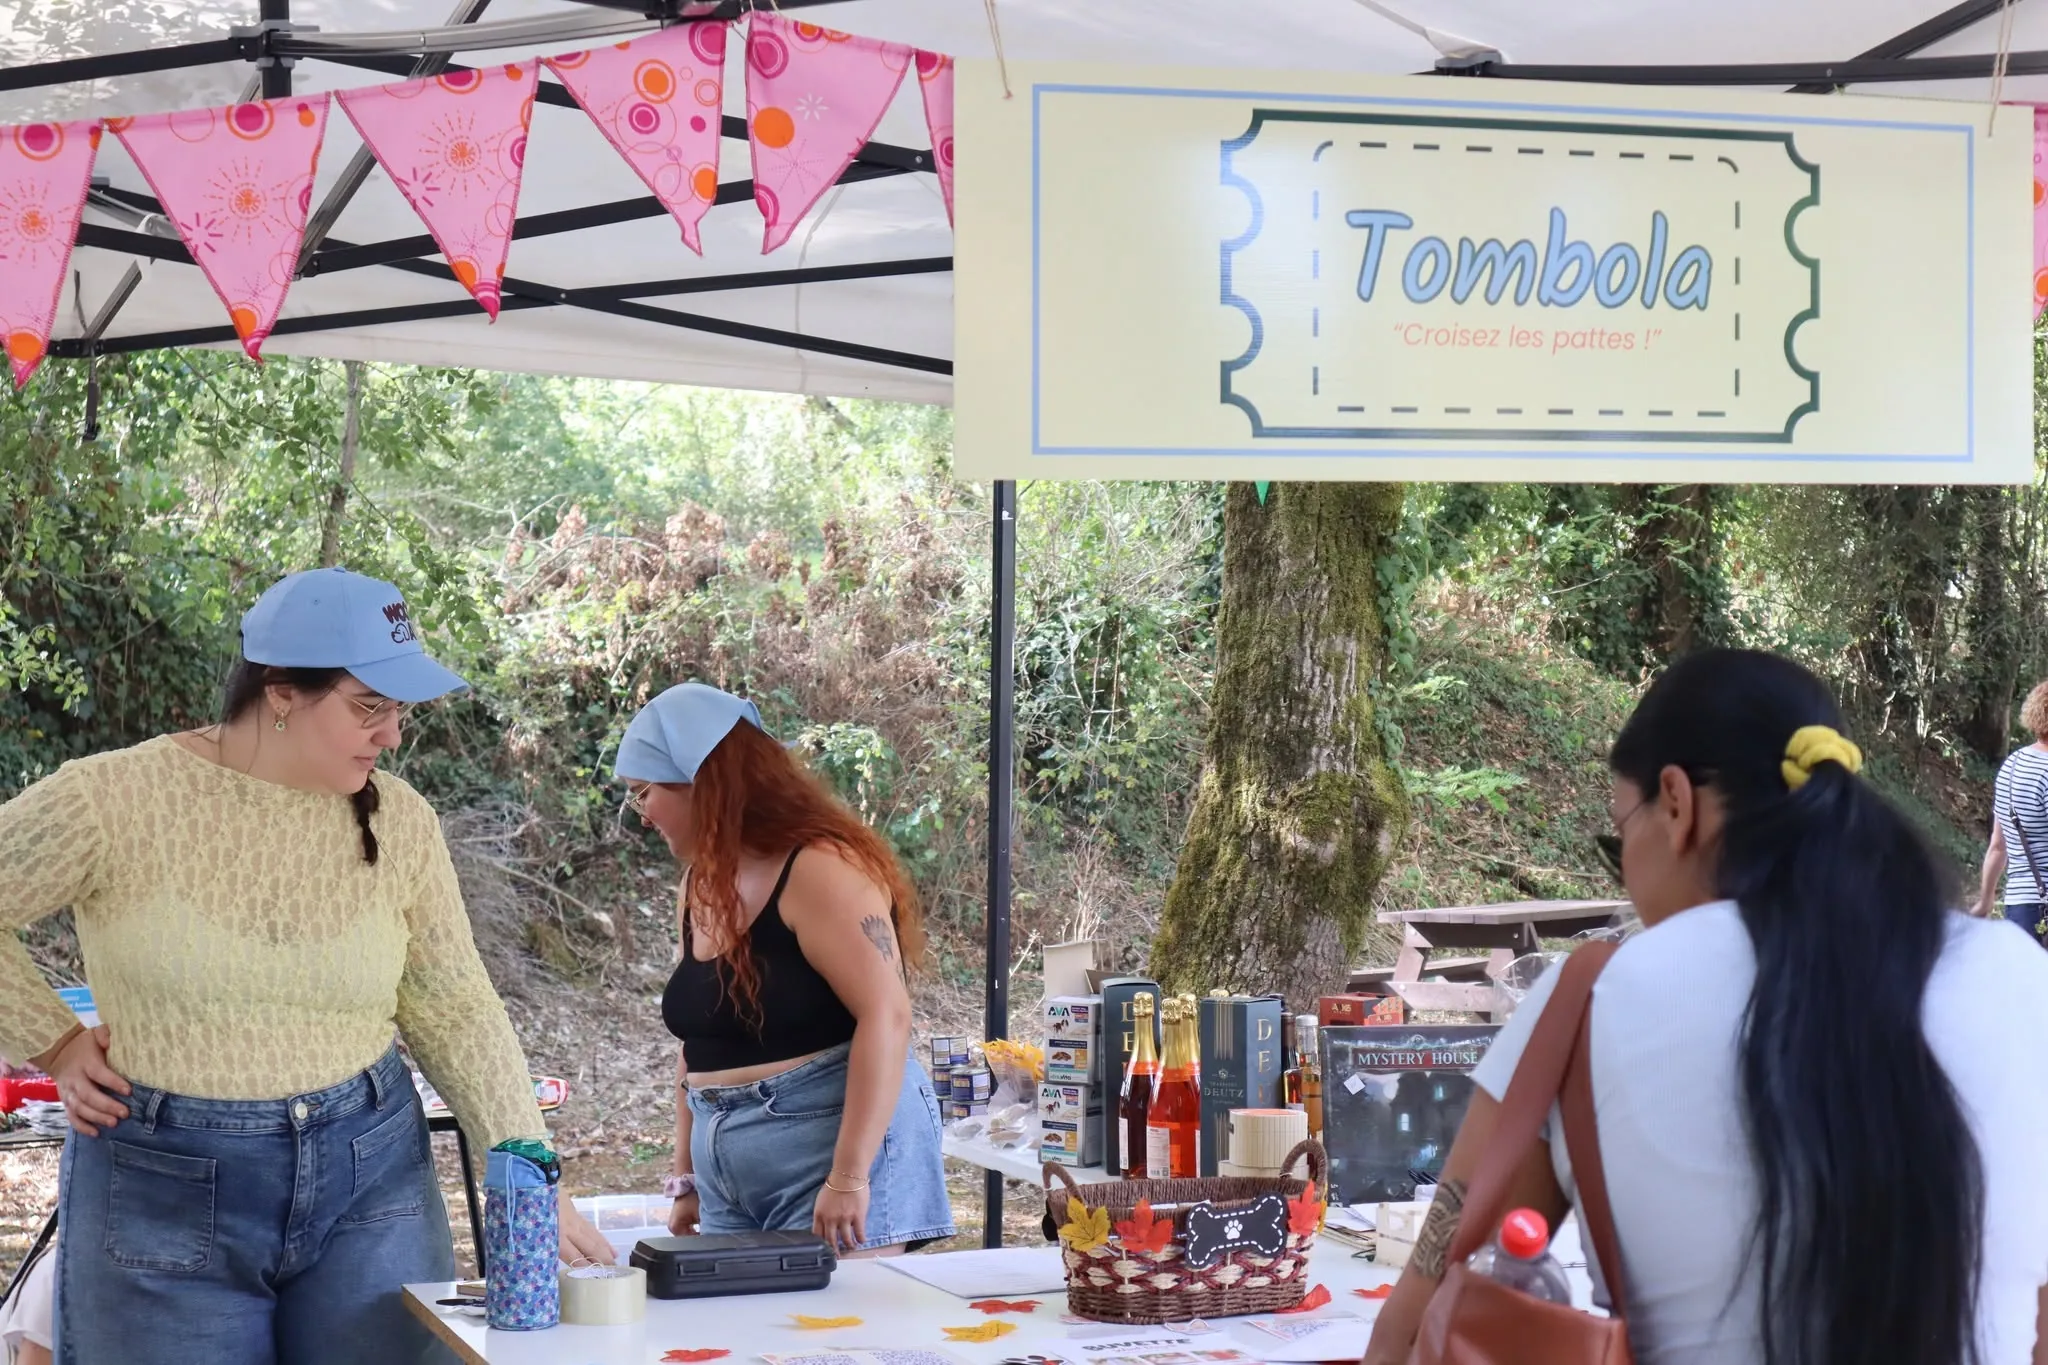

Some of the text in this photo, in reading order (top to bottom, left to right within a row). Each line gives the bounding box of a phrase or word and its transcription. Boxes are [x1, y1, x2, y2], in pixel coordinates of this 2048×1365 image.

[1345, 206, 1713, 311] Tombola
[1509, 325, 1543, 348] les
[1552, 327, 1635, 355] pattes
[1048, 1006, 1070, 1017] AVA
[1358, 1051, 1479, 1066] MYSTERY HOUSE
[1041, 1087, 1062, 1099] AVA
[1203, 1087, 1245, 1099] DEUTZ
